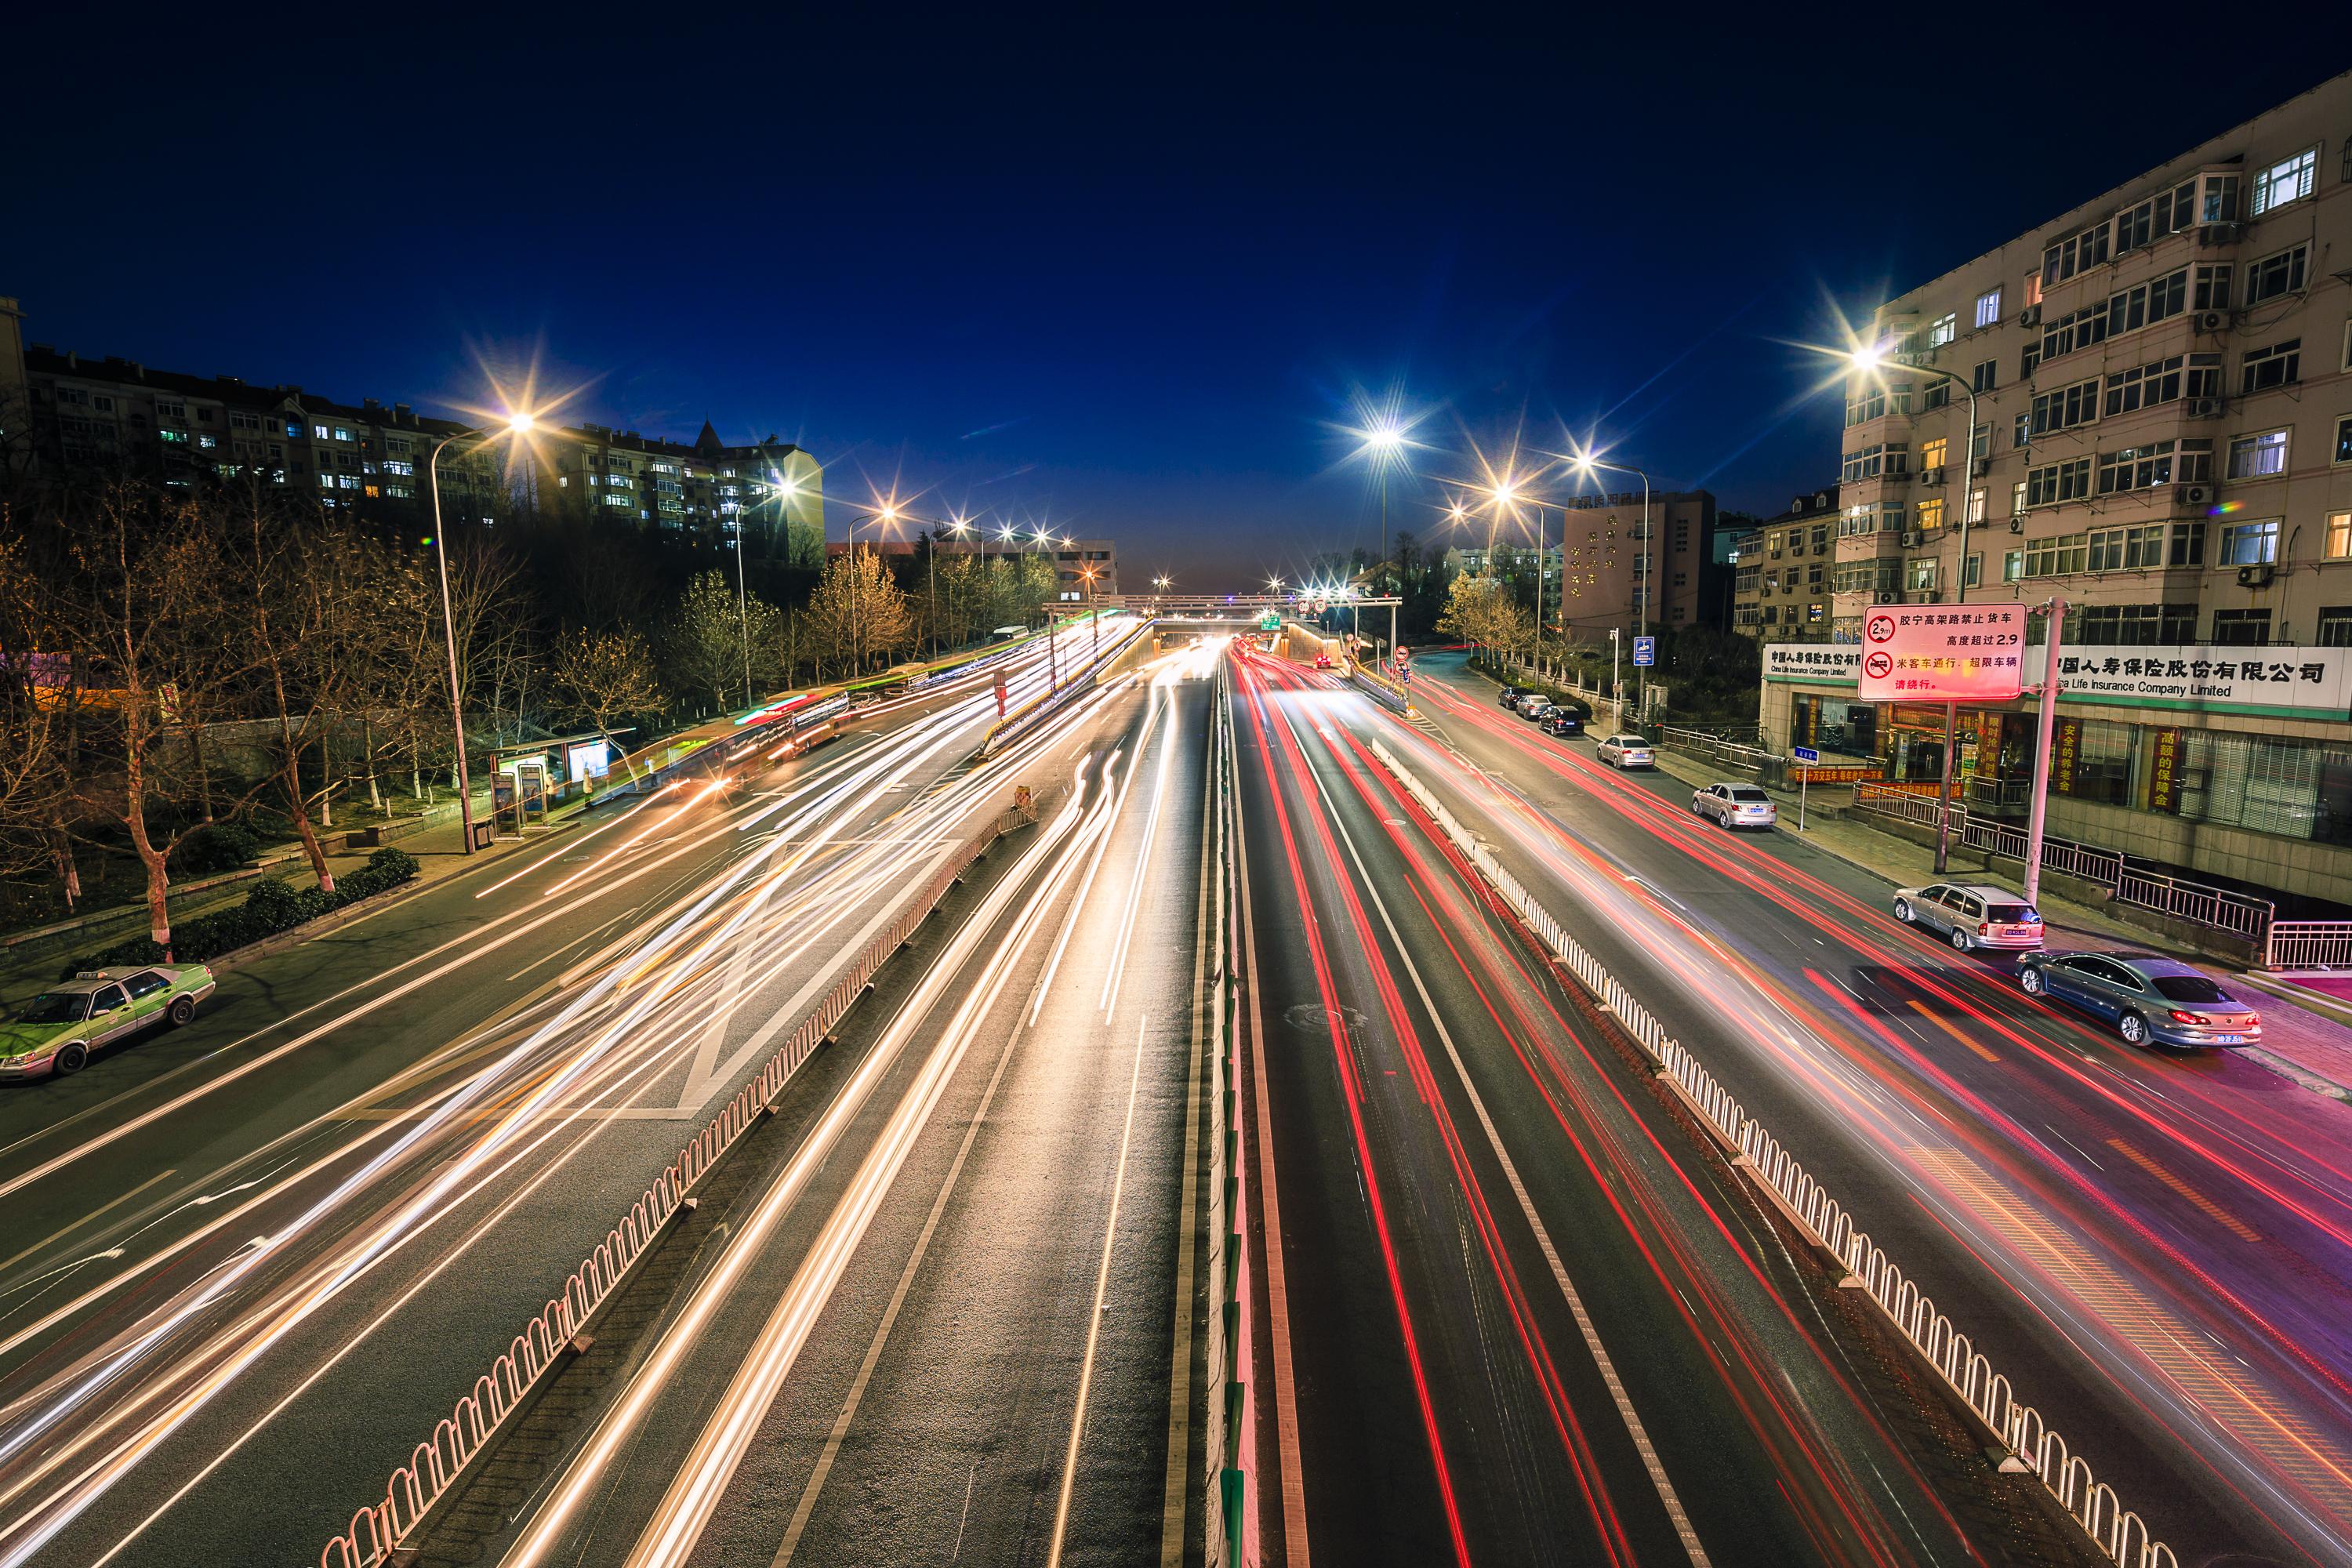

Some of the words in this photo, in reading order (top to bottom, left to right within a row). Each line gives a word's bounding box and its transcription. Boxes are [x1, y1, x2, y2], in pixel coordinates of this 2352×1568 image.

[1872, 623, 1891, 635] 2.9m
[1900, 613, 2012, 626] 胶宁高架路禁止货车
[1809, 667, 1830, 677] Company
[2057, 657, 2325, 684] 国人寿保险股份有限公司
[2072, 679, 2088, 689] Life
[2092, 679, 2135, 691] Insurance
[2138, 682, 2187, 697] Company
[2190, 685, 2231, 698] Limited
[2060, 725, 2076, 791] 安全的养老金
[2155, 732, 2175, 806] 高额的保障金
